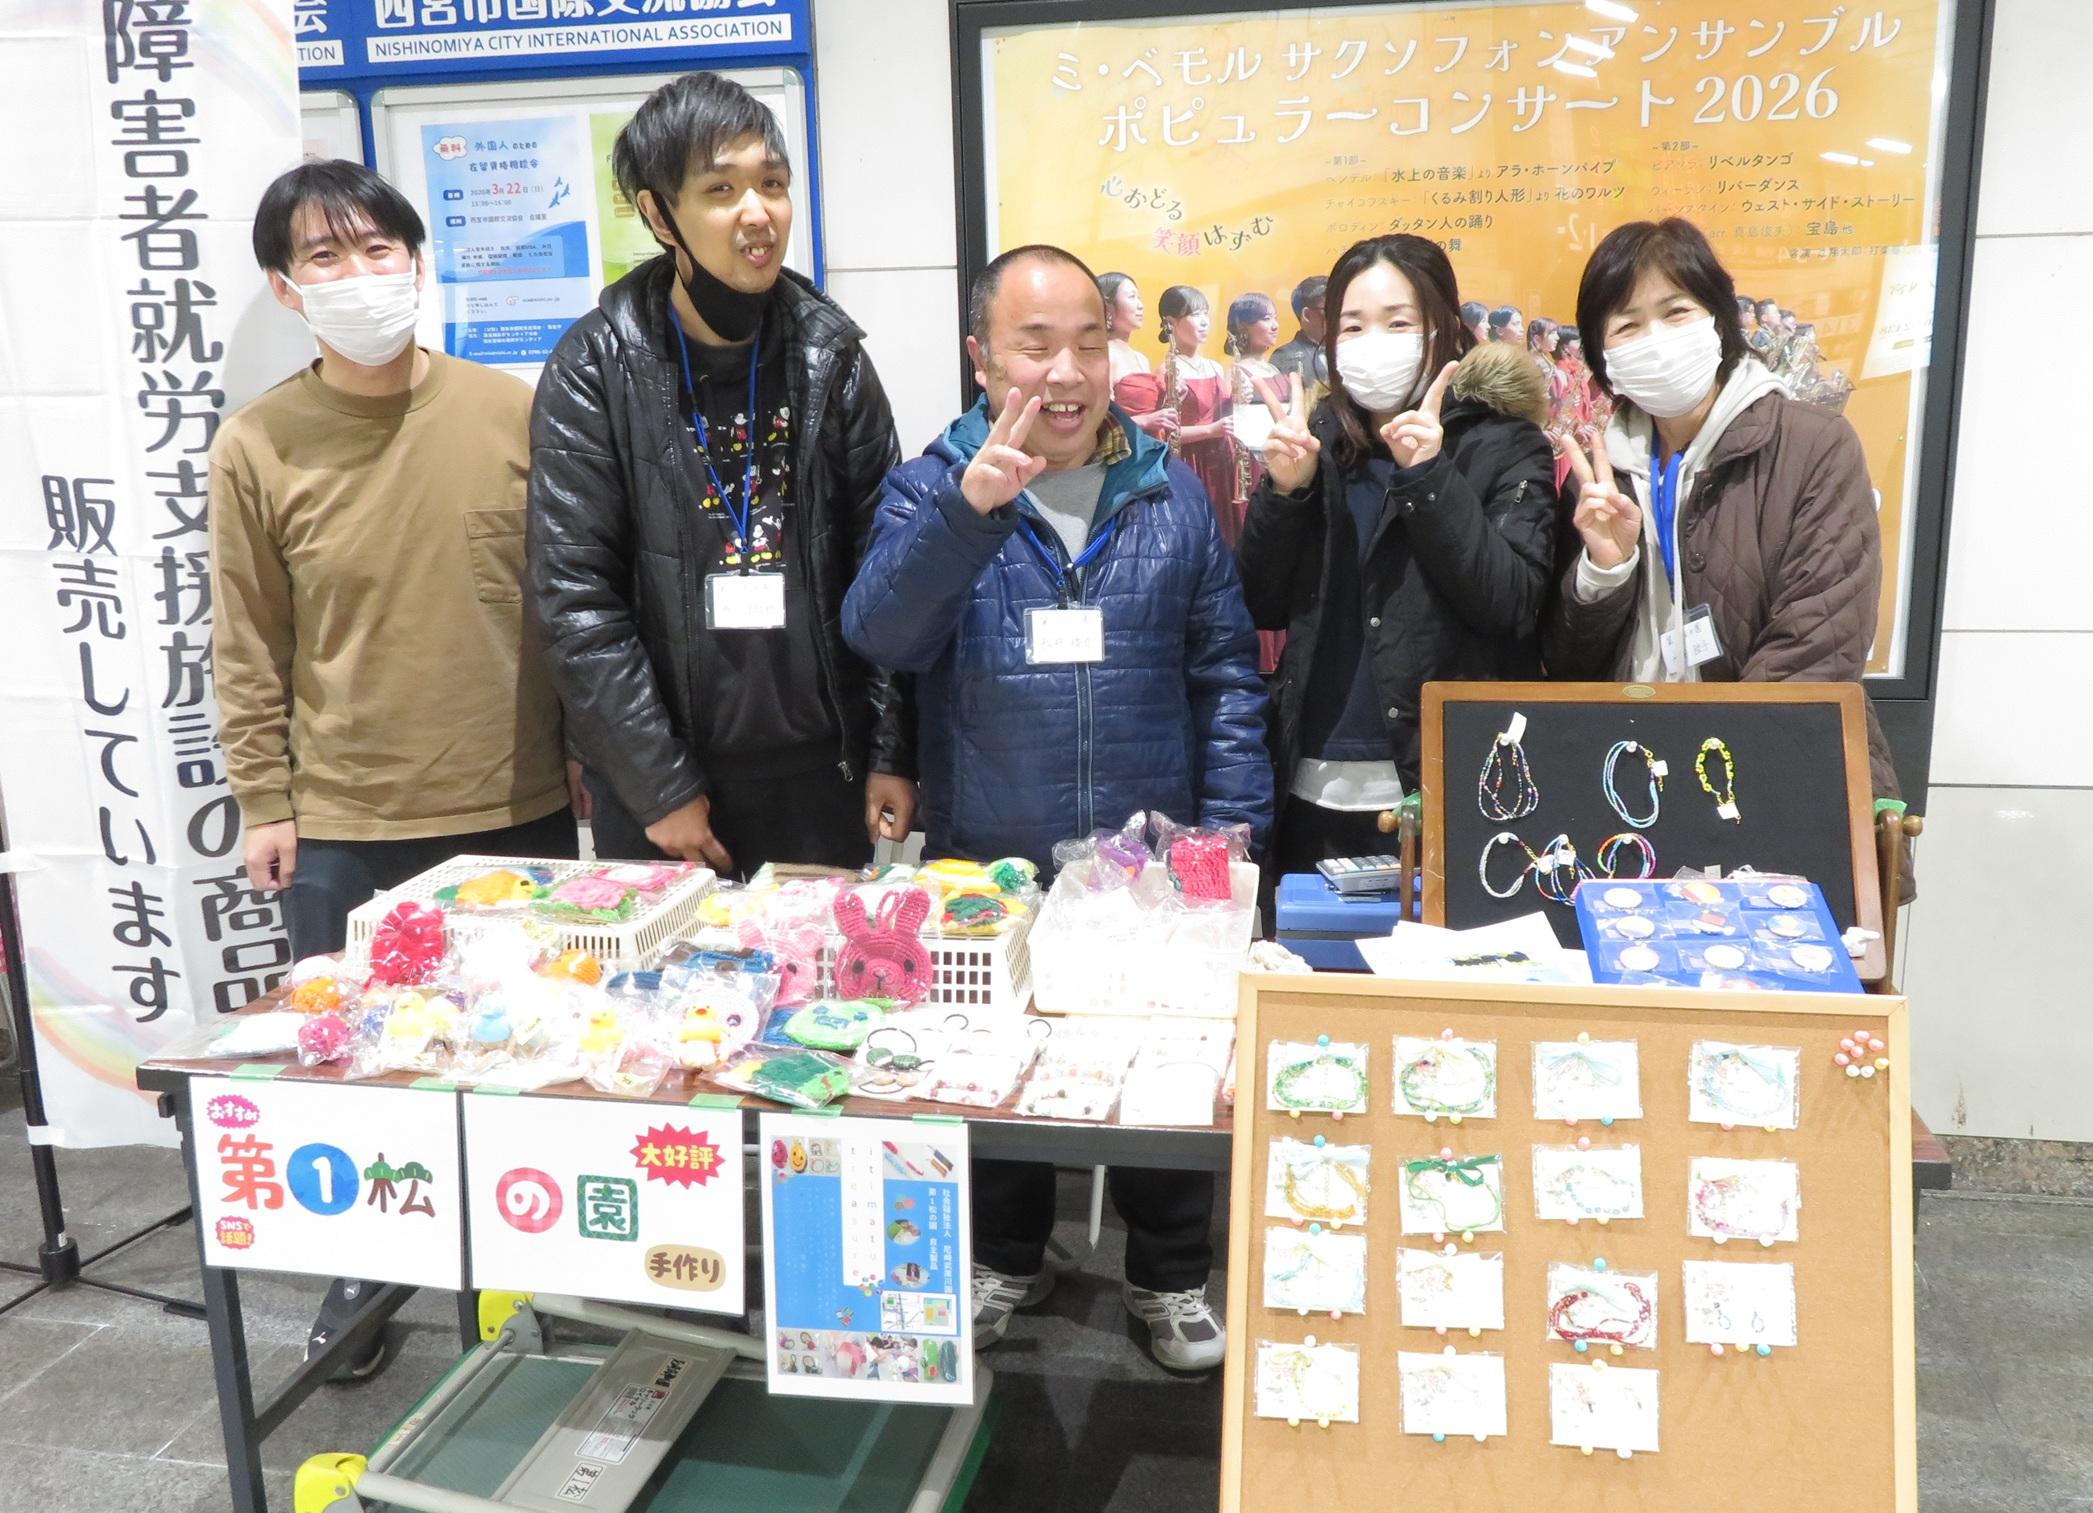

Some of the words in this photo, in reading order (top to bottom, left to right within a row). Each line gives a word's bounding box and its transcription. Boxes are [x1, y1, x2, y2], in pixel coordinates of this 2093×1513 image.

[375, 38, 485, 57] NISHINOMIYA
[488, 35, 523, 50] CITY
[528, 28, 663, 48] INTERNATIONAL
[668, 20, 782, 41] ASSOCIATION
[1708, 151, 1794, 170] リベルタンゴ
[1554, 185, 1626, 202] 花のワルツ
[1717, 176, 1800, 195] リバーダンス
[1742, 193, 1915, 213] ウェスト・サイド・ストーリー
[1389, 214, 1495, 233] ダッタン人の踊り
[42, 475, 182, 1023] 販売しています
[210, 1100, 258, 1122] おすすめ
[640, 1142, 715, 1171] 大好評
[649, 1251, 720, 1284] 手作り
